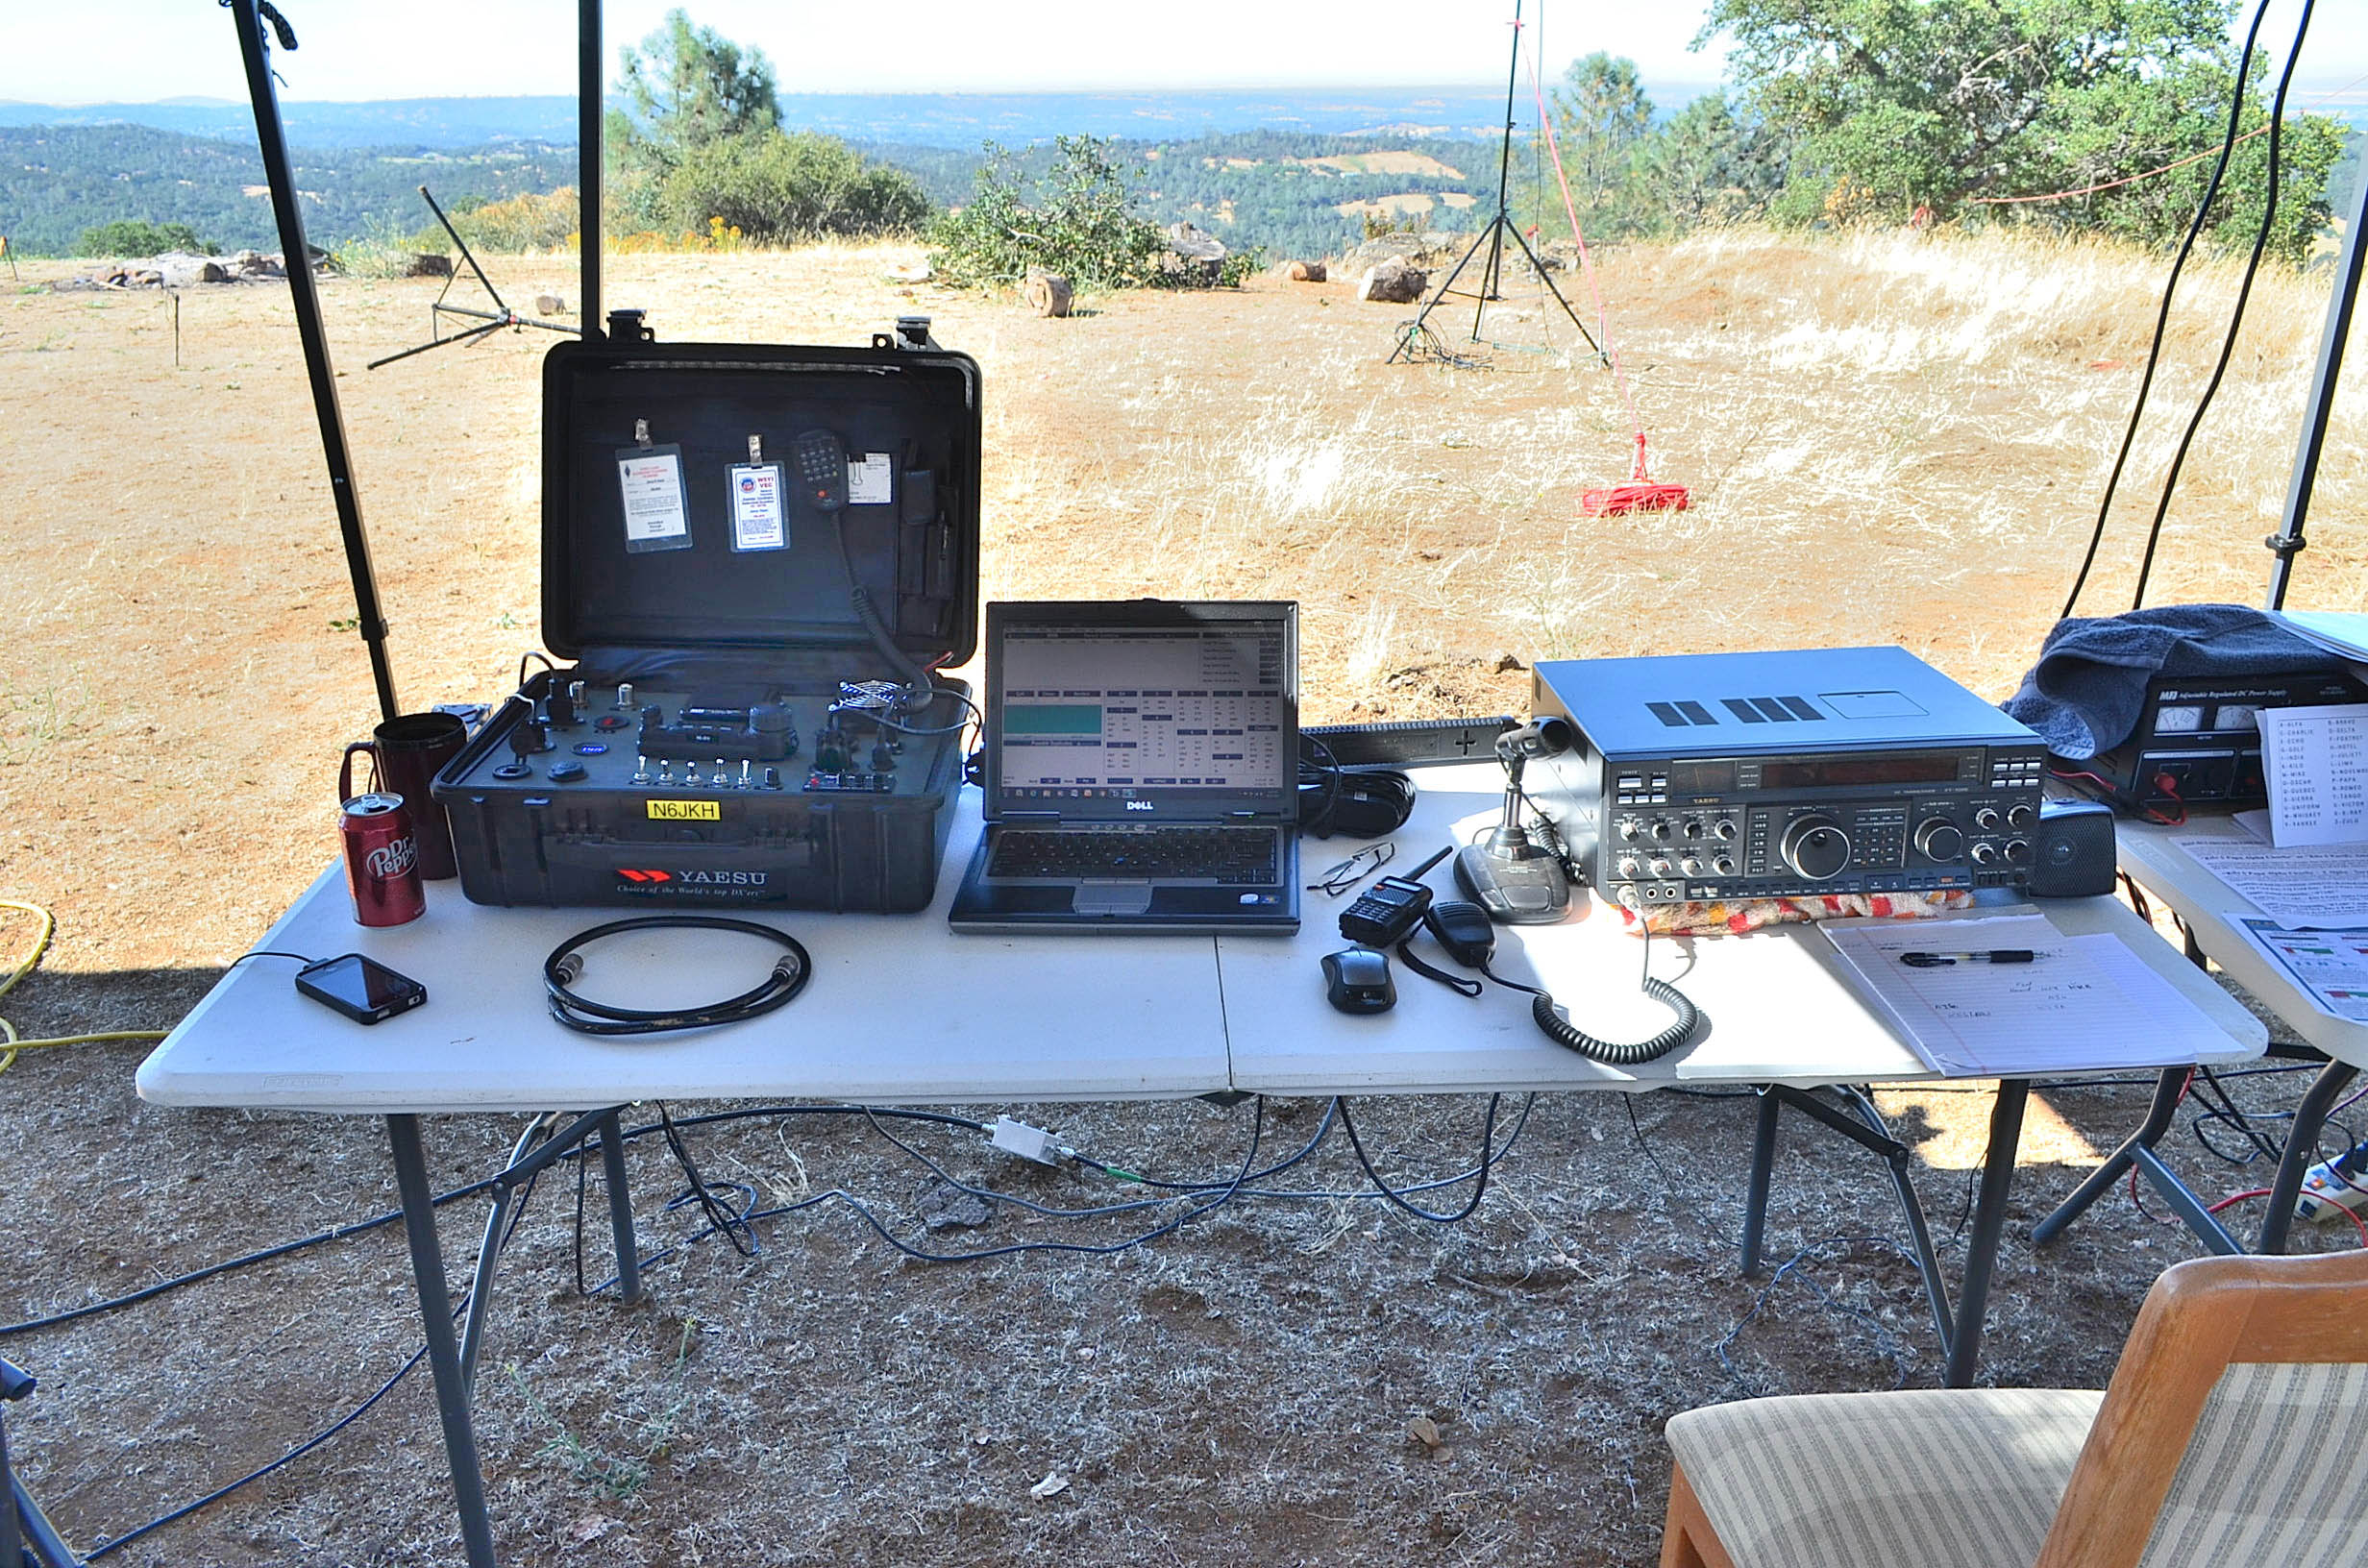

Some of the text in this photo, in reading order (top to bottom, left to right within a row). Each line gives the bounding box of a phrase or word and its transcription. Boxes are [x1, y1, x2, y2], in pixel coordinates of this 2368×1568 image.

[654, 802, 715, 819] N6JKH
[1127, 801, 1153, 810] DELL
[388, 836, 409, 858] Dr
[678, 870, 767, 885] YAESU
[617, 885, 646, 894] Choice
[648, 885, 658, 894] of
[661, 885, 676, 894] the
[678, 886, 709, 895] World's
[714, 887, 728, 897] top
